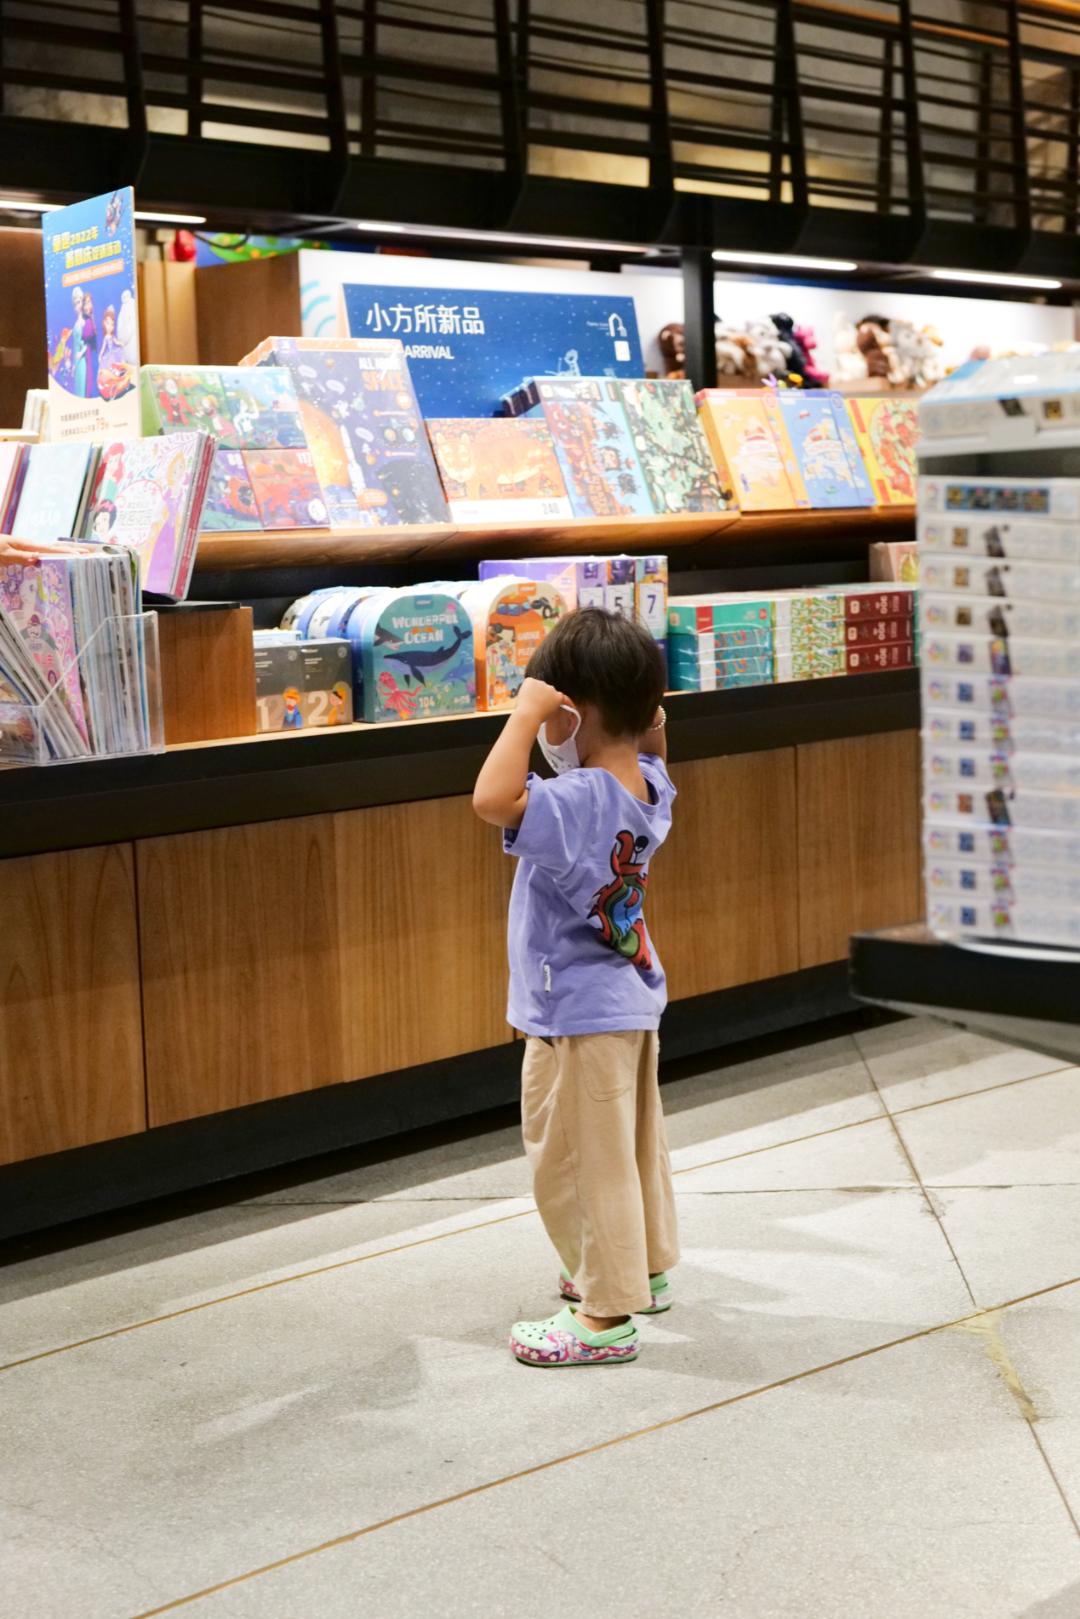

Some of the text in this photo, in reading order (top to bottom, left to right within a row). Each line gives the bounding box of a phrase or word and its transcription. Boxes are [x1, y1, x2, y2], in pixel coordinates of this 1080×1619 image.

[365, 302, 485, 335] 小方所新品
[404, 344, 455, 360] ARRIVAL
[647, 594, 657, 614] 7
[391, 613, 459, 629] WONDERFUL
[404, 629, 444, 645] OCEAN
[307, 691, 328, 725] 2
